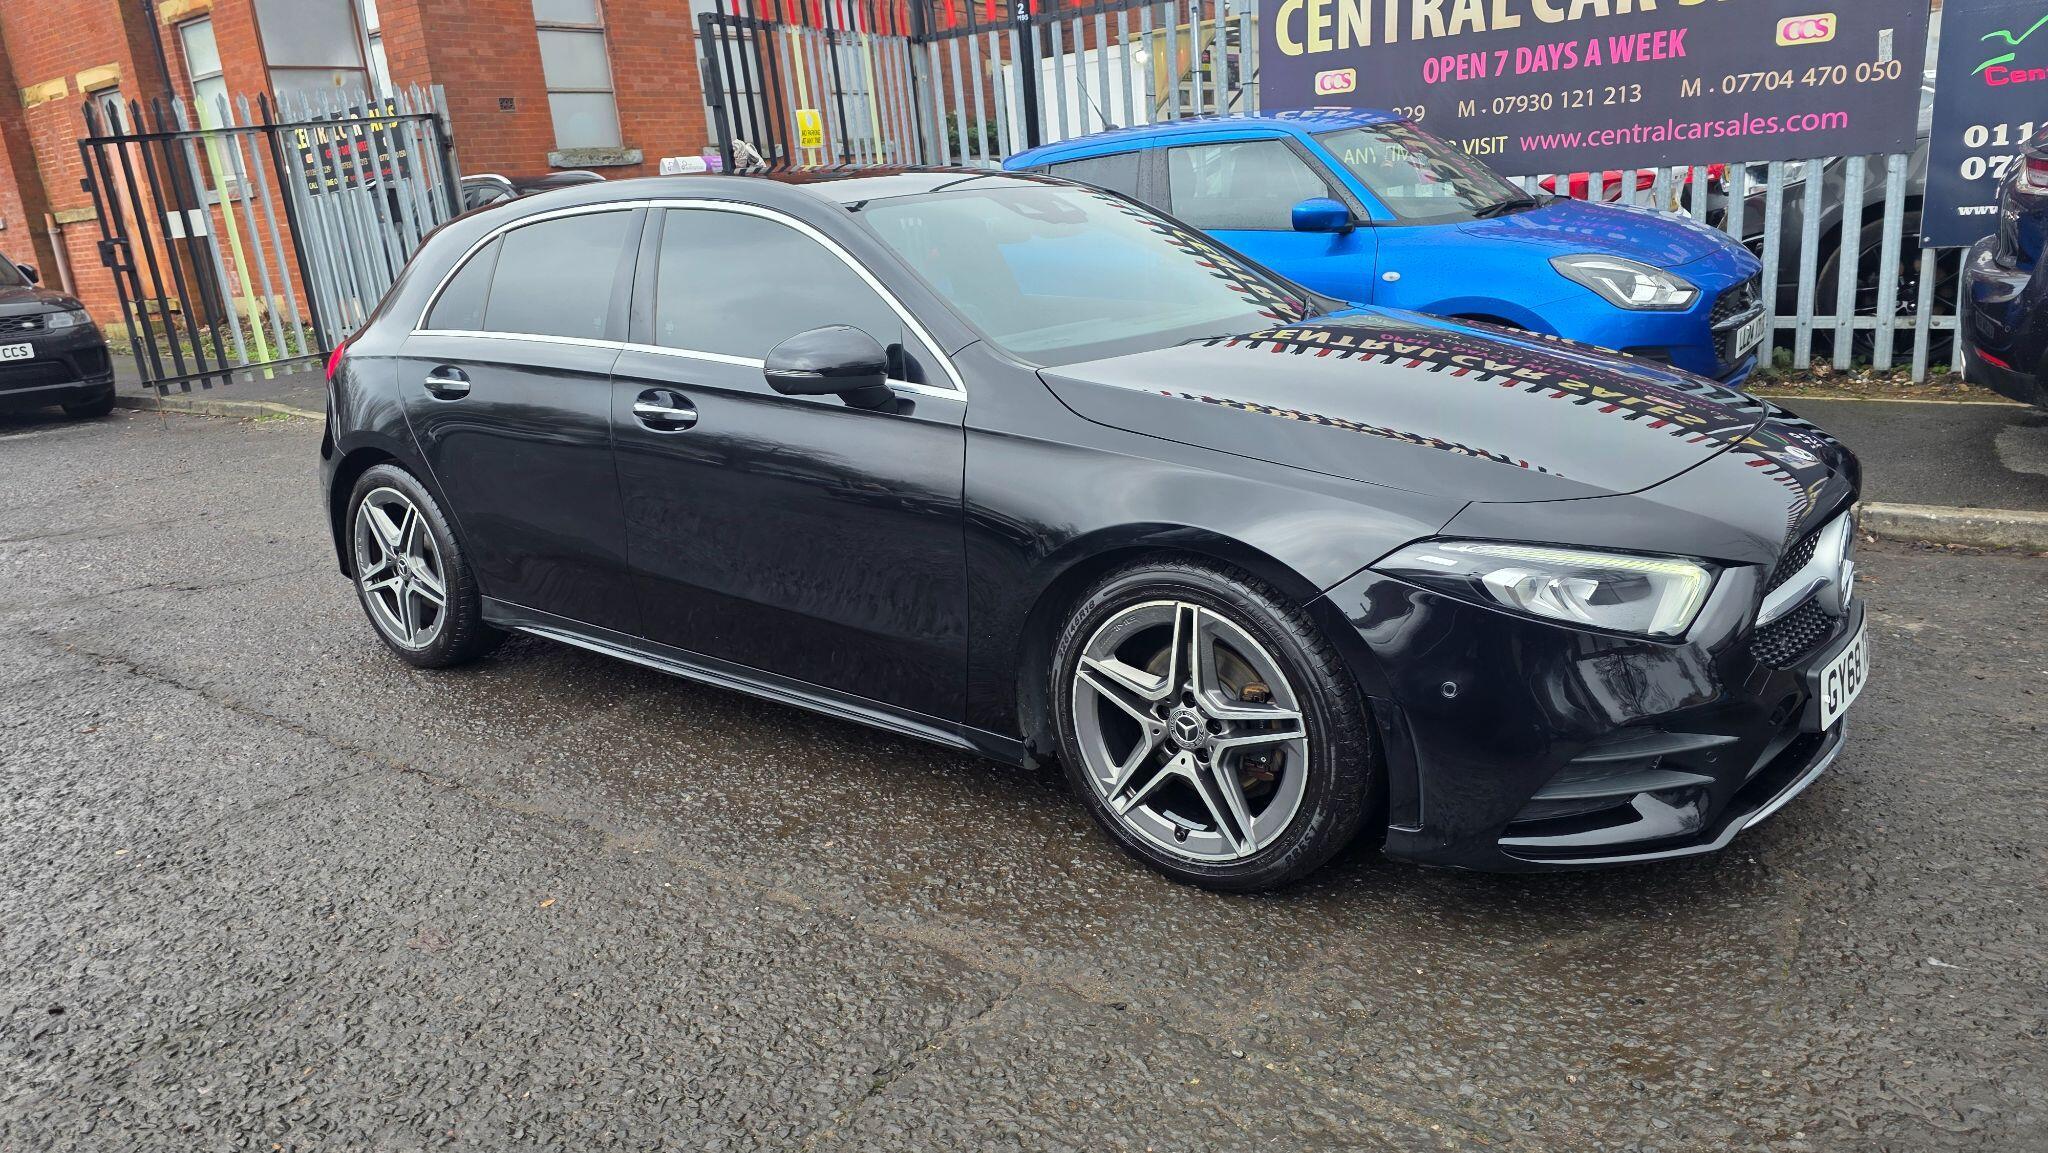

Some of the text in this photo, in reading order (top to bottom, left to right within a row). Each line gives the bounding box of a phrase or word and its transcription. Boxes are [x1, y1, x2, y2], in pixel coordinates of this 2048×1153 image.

[1423, 28, 1688, 84] OPEN 7 DAYS A WEEK
[1984, 66, 2048, 86] Cen
[1492, 93, 1553, 115] 07930
[1562, 89, 1593, 108] 121
[1604, 84, 1642, 105] 213
[1722, 69, 1793, 95] 07704
[1801, 64, 1847, 88] 470
[1855, 59, 1902, 83] 050
[1462, 136, 1509, 155] VISIT
[1519, 111, 1848, 151] www.centralcarsales.com
[1964, 121, 2048, 148] 011
[2, 346, 28, 358] CCS
[1828, 641, 1860, 715] GY68
